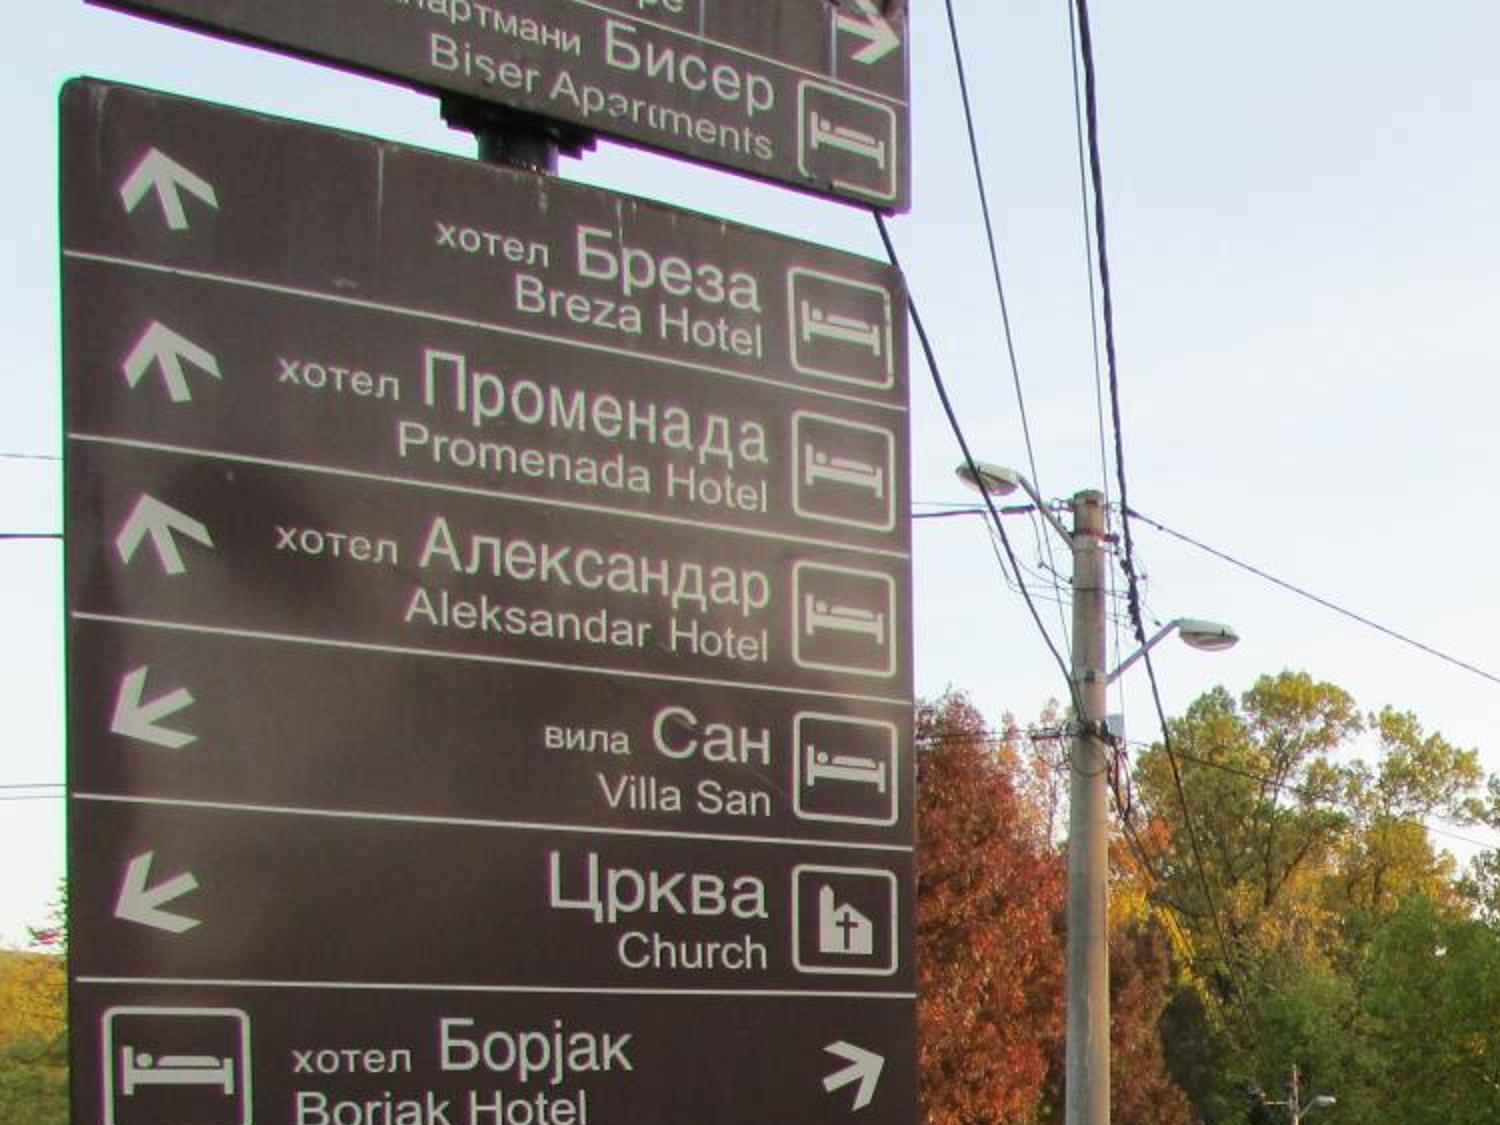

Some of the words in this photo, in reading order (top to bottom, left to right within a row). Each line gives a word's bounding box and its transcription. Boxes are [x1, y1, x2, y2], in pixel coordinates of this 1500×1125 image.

[404, 0, 580, 56] артмани
[605, 18, 775, 114] Бисер
[431, 33, 540, 93] Biser
[549, 70, 774, 160] Apartments
[436, 222, 548, 267] хотел
[577, 226, 762, 309] Бреза
[515, 273, 641, 334] Breza
[660, 304, 762, 358] Hotel
[279, 358, 399, 400] хотел
[424, 349, 768, 467] Променада
[398, 420, 650, 493] Promenada
[668, 464, 766, 512] Hotel
[276, 526, 397, 564] хотел
[419, 517, 769, 616] Александар
[404, 588, 651, 648] Aleksandar
[670, 617, 767, 662] Hotel
[544, 725, 631, 755] вила
[653, 706, 770, 765] Сан
[597, 773, 681, 812] Villa
[697, 780, 770, 816] San
[549, 850, 768, 923] Црква
[618, 931, 767, 970] Church
[292, 1049, 411, 1074] хотел
[440, 1017, 633, 1085] Борјак
